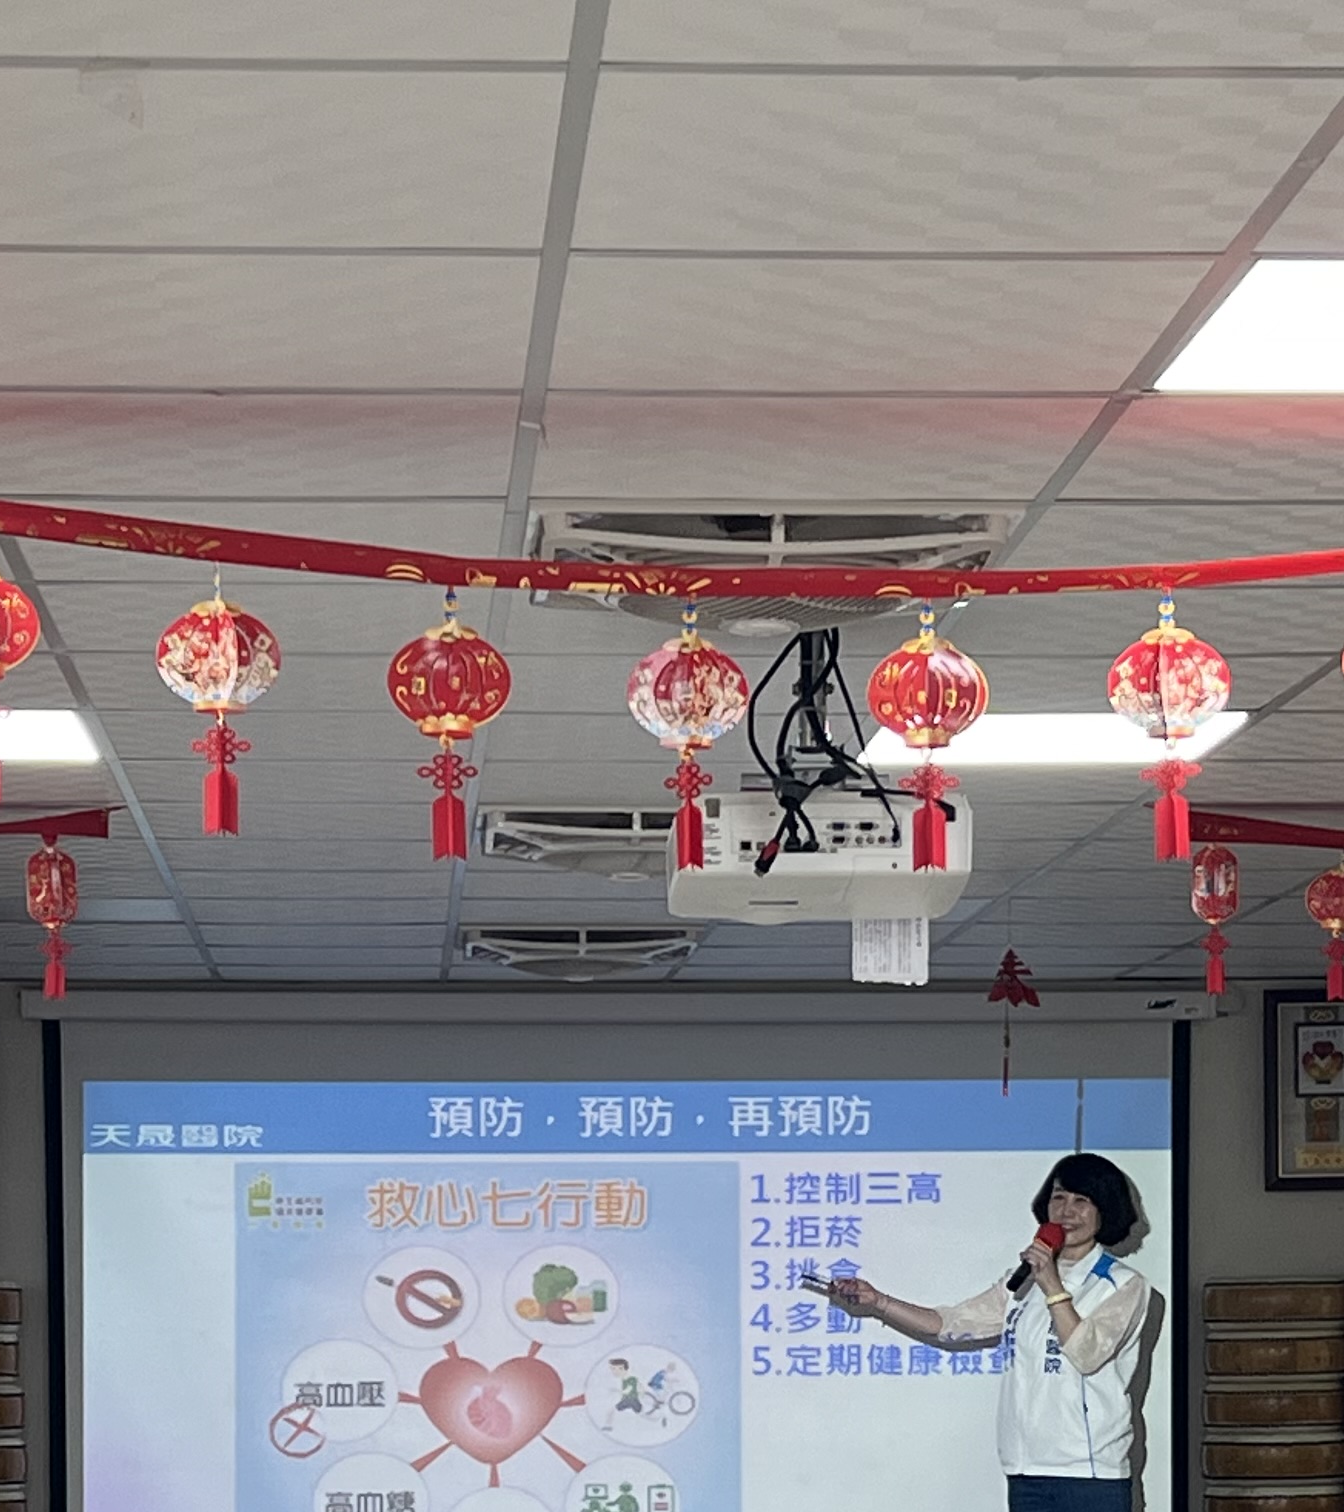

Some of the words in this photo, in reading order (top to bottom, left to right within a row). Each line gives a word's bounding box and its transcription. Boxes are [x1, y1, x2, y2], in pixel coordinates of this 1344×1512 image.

[751, 1171, 942, 1204] 1.控制三高
[367, 1180, 647, 1230] 救心七行動
[751, 1215, 863, 1248] 2.拒菸
[294, 1380, 386, 1408] 高血壓
